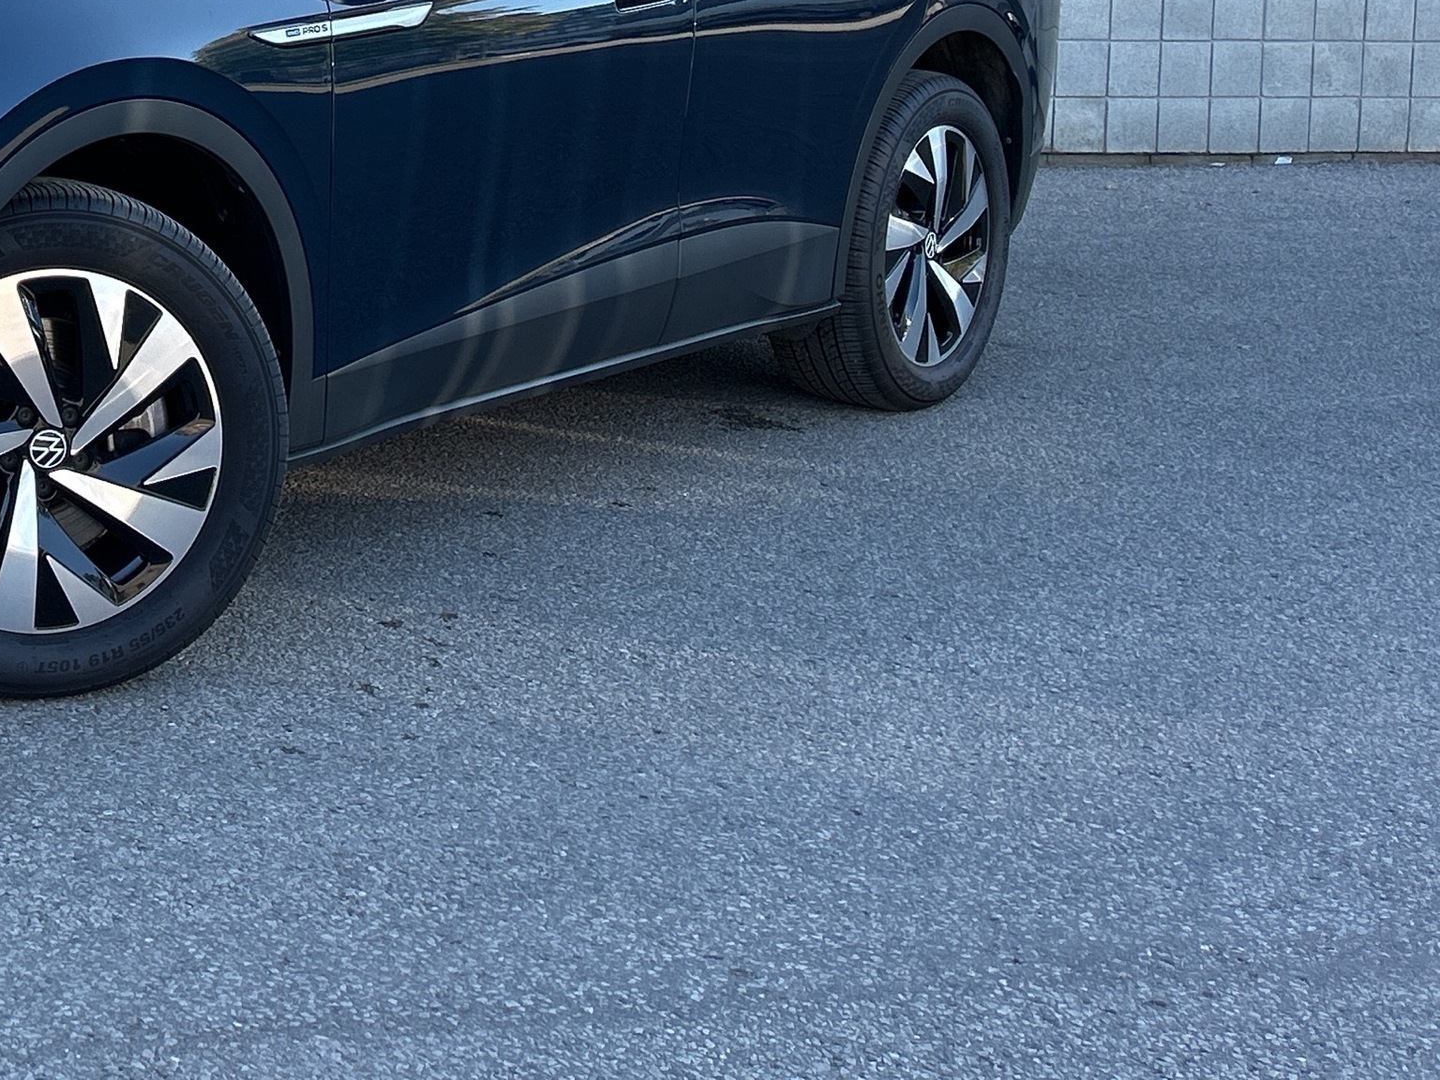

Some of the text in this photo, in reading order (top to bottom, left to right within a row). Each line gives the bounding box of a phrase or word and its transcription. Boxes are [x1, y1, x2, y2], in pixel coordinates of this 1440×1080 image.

[302, 25, 320, 35] PRO
[321, 23, 328, 32] S
[35, 607, 186, 674] 235/55 R19 105T
